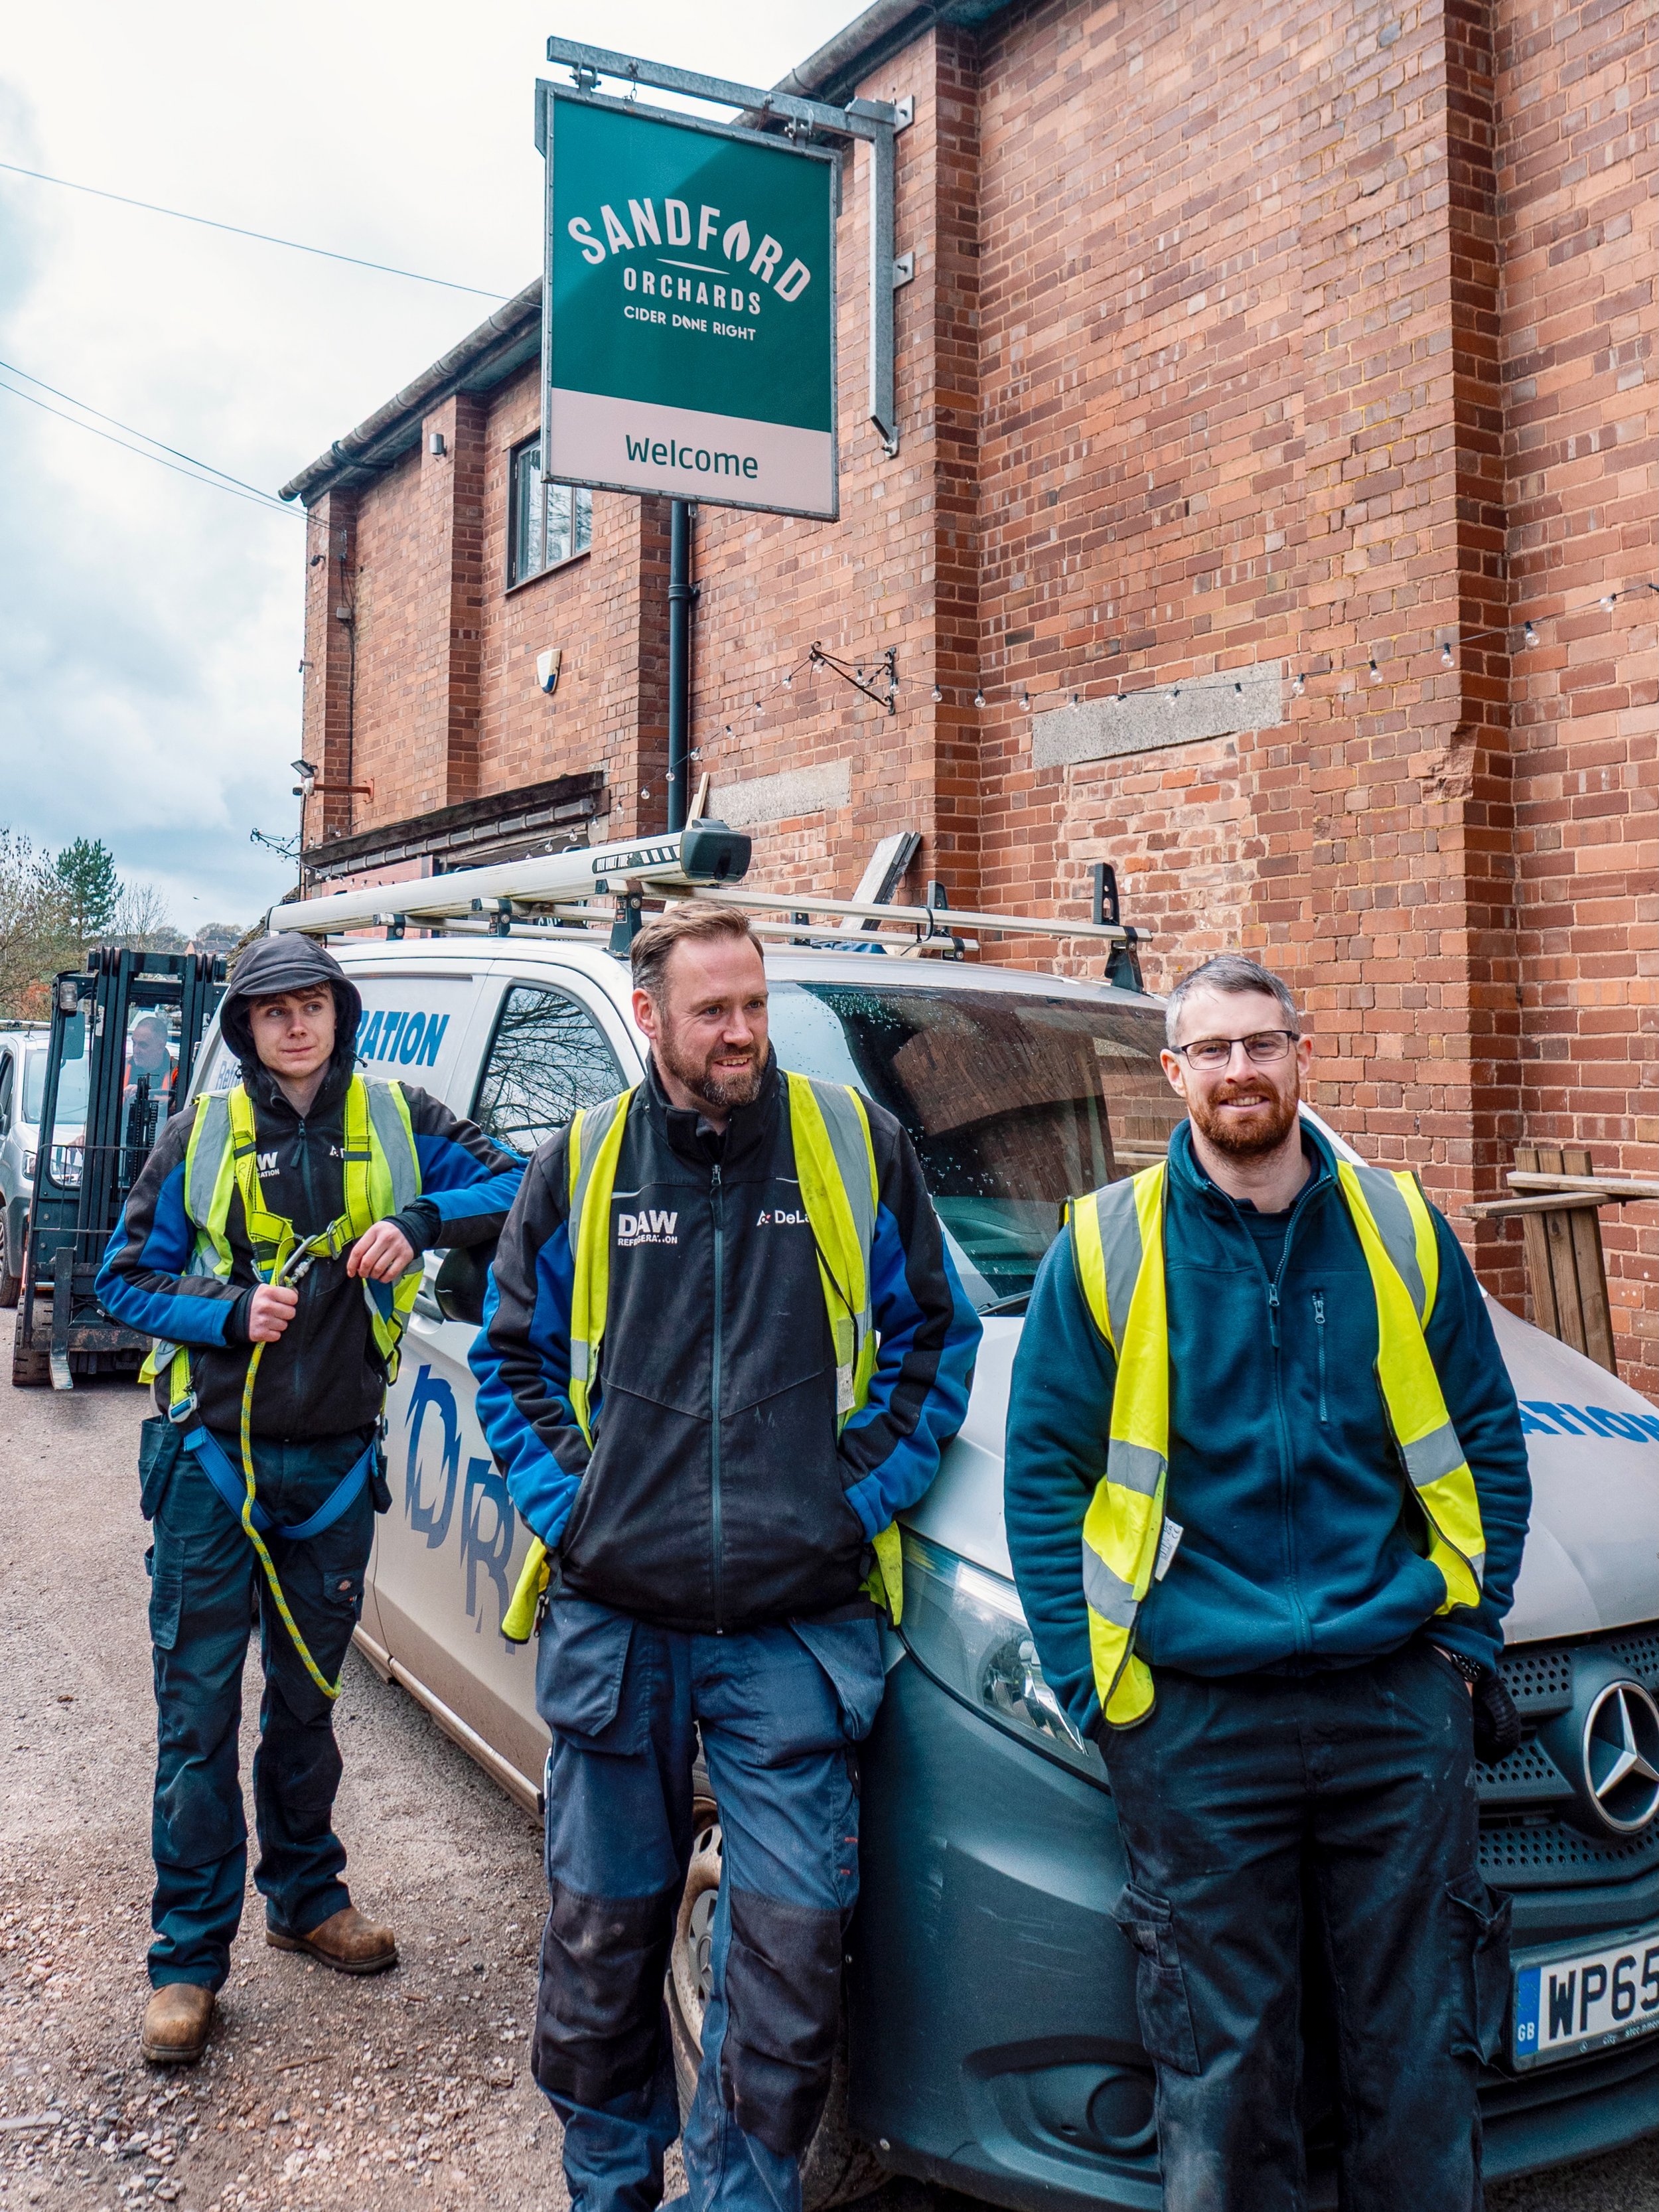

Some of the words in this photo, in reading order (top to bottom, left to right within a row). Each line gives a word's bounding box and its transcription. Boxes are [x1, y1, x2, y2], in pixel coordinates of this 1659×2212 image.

[568, 198, 811, 302] SANDFORD
[624, 267, 760, 315] ORCHARDS
[624, 305, 666, 325] CIDER
[672, 314, 707, 332] DONE
[713, 322, 756, 340] RIGHT
[626, 434, 758, 479] Welcome
[618, 1210, 678, 1237] DAW
[1549, 1945, 1659, 2041] WP65
[1518, 2022, 1534, 2041] GB
